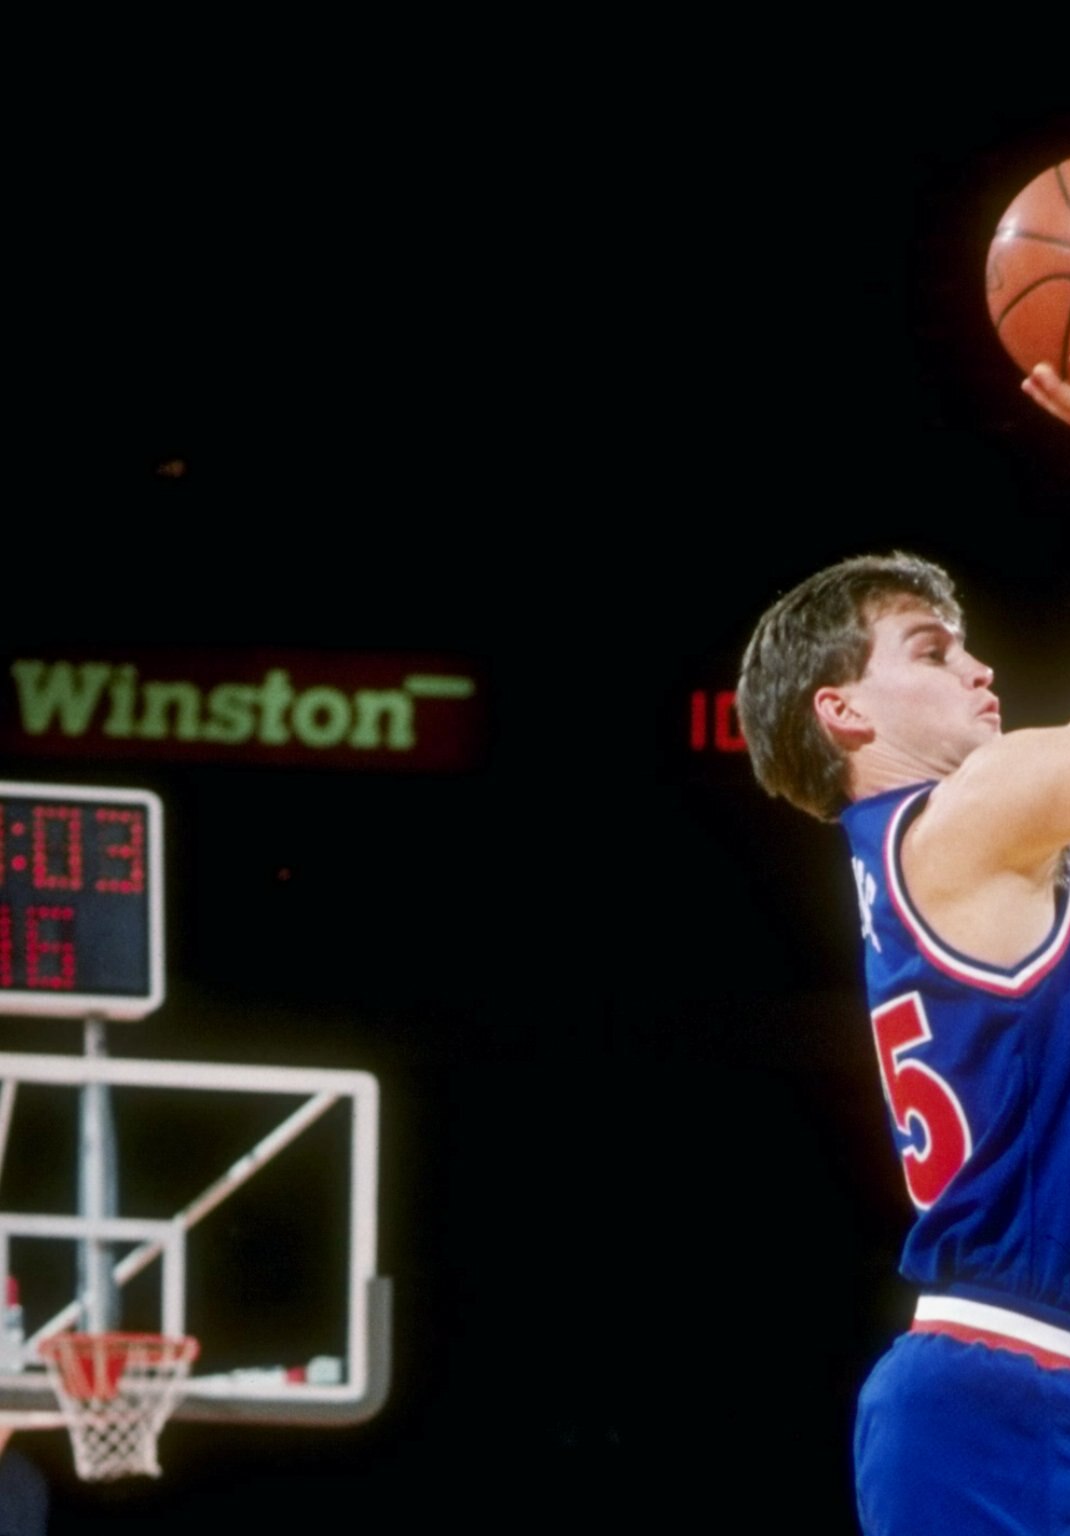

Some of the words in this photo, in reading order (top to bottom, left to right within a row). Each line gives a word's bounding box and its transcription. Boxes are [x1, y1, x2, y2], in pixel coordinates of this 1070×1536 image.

[11, 659, 415, 751] Winston
[0, 804, 144, 894] :03
[870, 991, 973, 1212] 5
